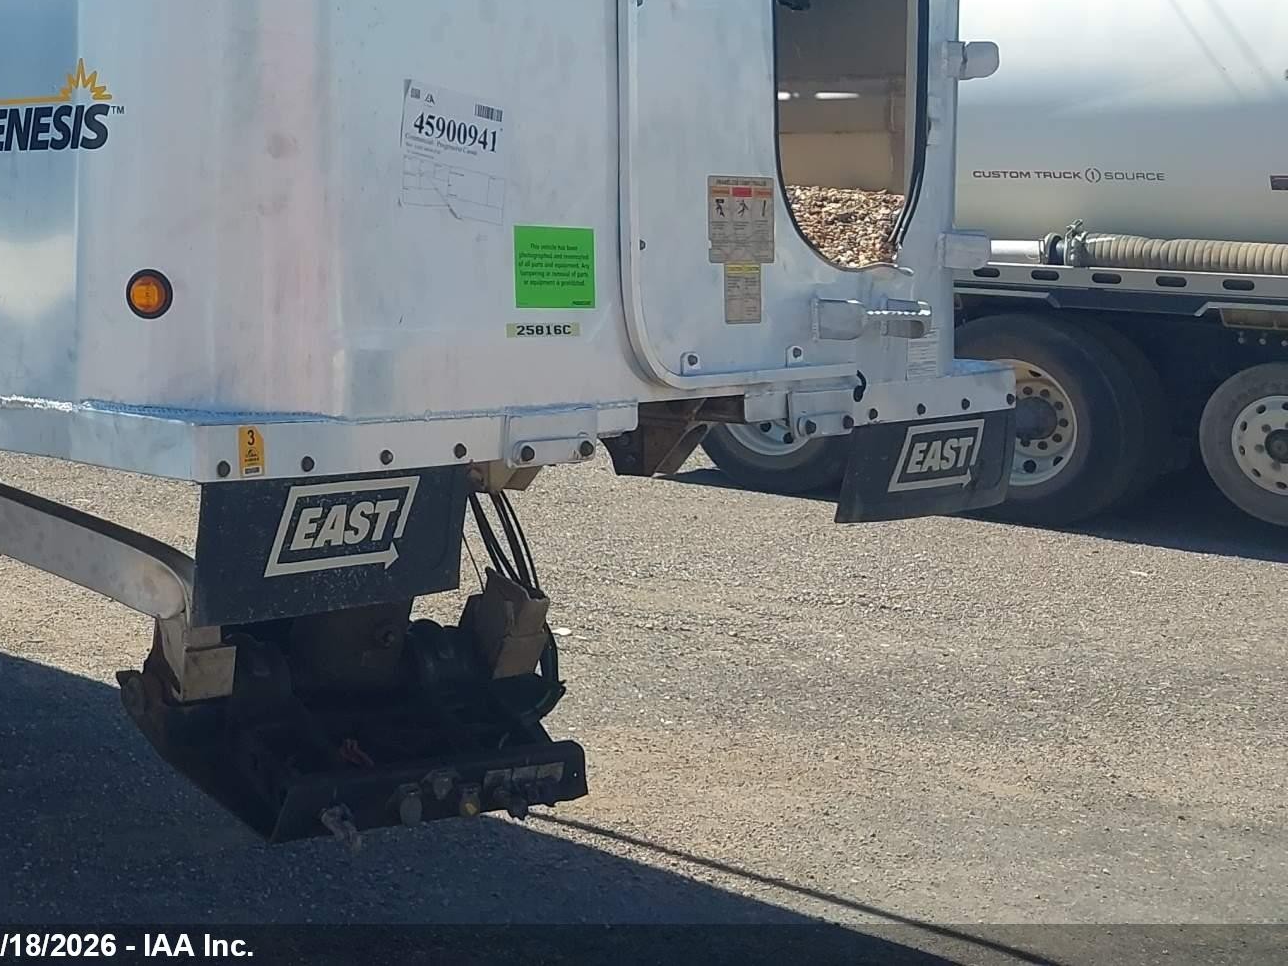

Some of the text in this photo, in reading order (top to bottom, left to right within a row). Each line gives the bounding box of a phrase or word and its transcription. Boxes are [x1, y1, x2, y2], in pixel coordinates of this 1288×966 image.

[413, 112, 497, 153] 45900941
[972, 170, 1032, 179] CUSTOM
[1034, 171, 1082, 180] TRUCK
[1104, 171, 1166, 181] SOURCE
[516, 324, 572, 336] 25816C
[247, 429, 255, 446] 3
[906, 437, 974, 474] EAST
[289, 499, 400, 551] EAST
